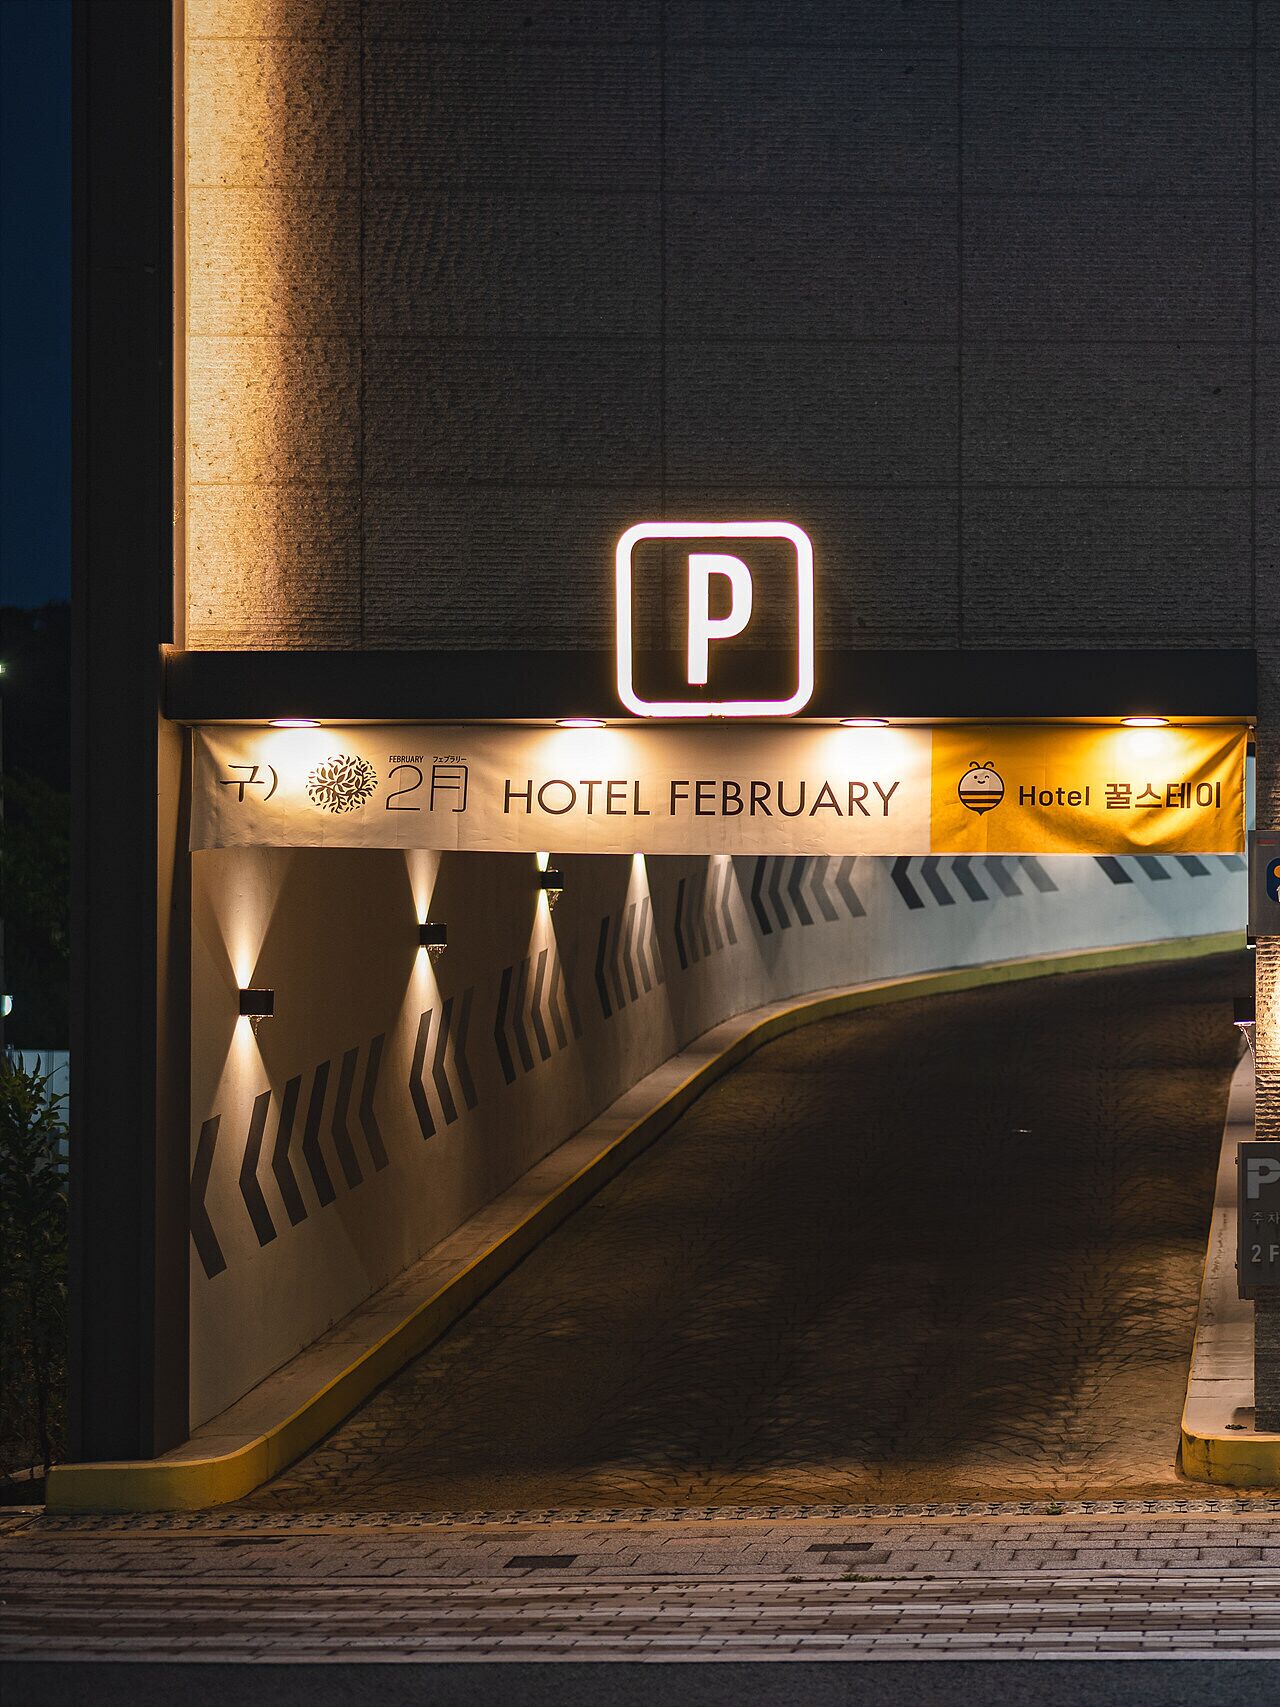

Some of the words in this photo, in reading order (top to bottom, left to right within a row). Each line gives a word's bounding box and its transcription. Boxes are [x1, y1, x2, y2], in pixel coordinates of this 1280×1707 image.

[687, 553, 753, 685] P
[388, 755, 425, 763] FEBRUARY
[432, 755, 467, 763] フェブラリー
[219, 763, 278, 804] 구)
[386, 764, 469, 813] 2月
[502, 779, 651, 815] HOTEL
[669, 780, 901, 817] FEBRUARY
[1019, 785, 1091, 807] Hotel
[1104, 781, 1222, 810] 꿀스테이
